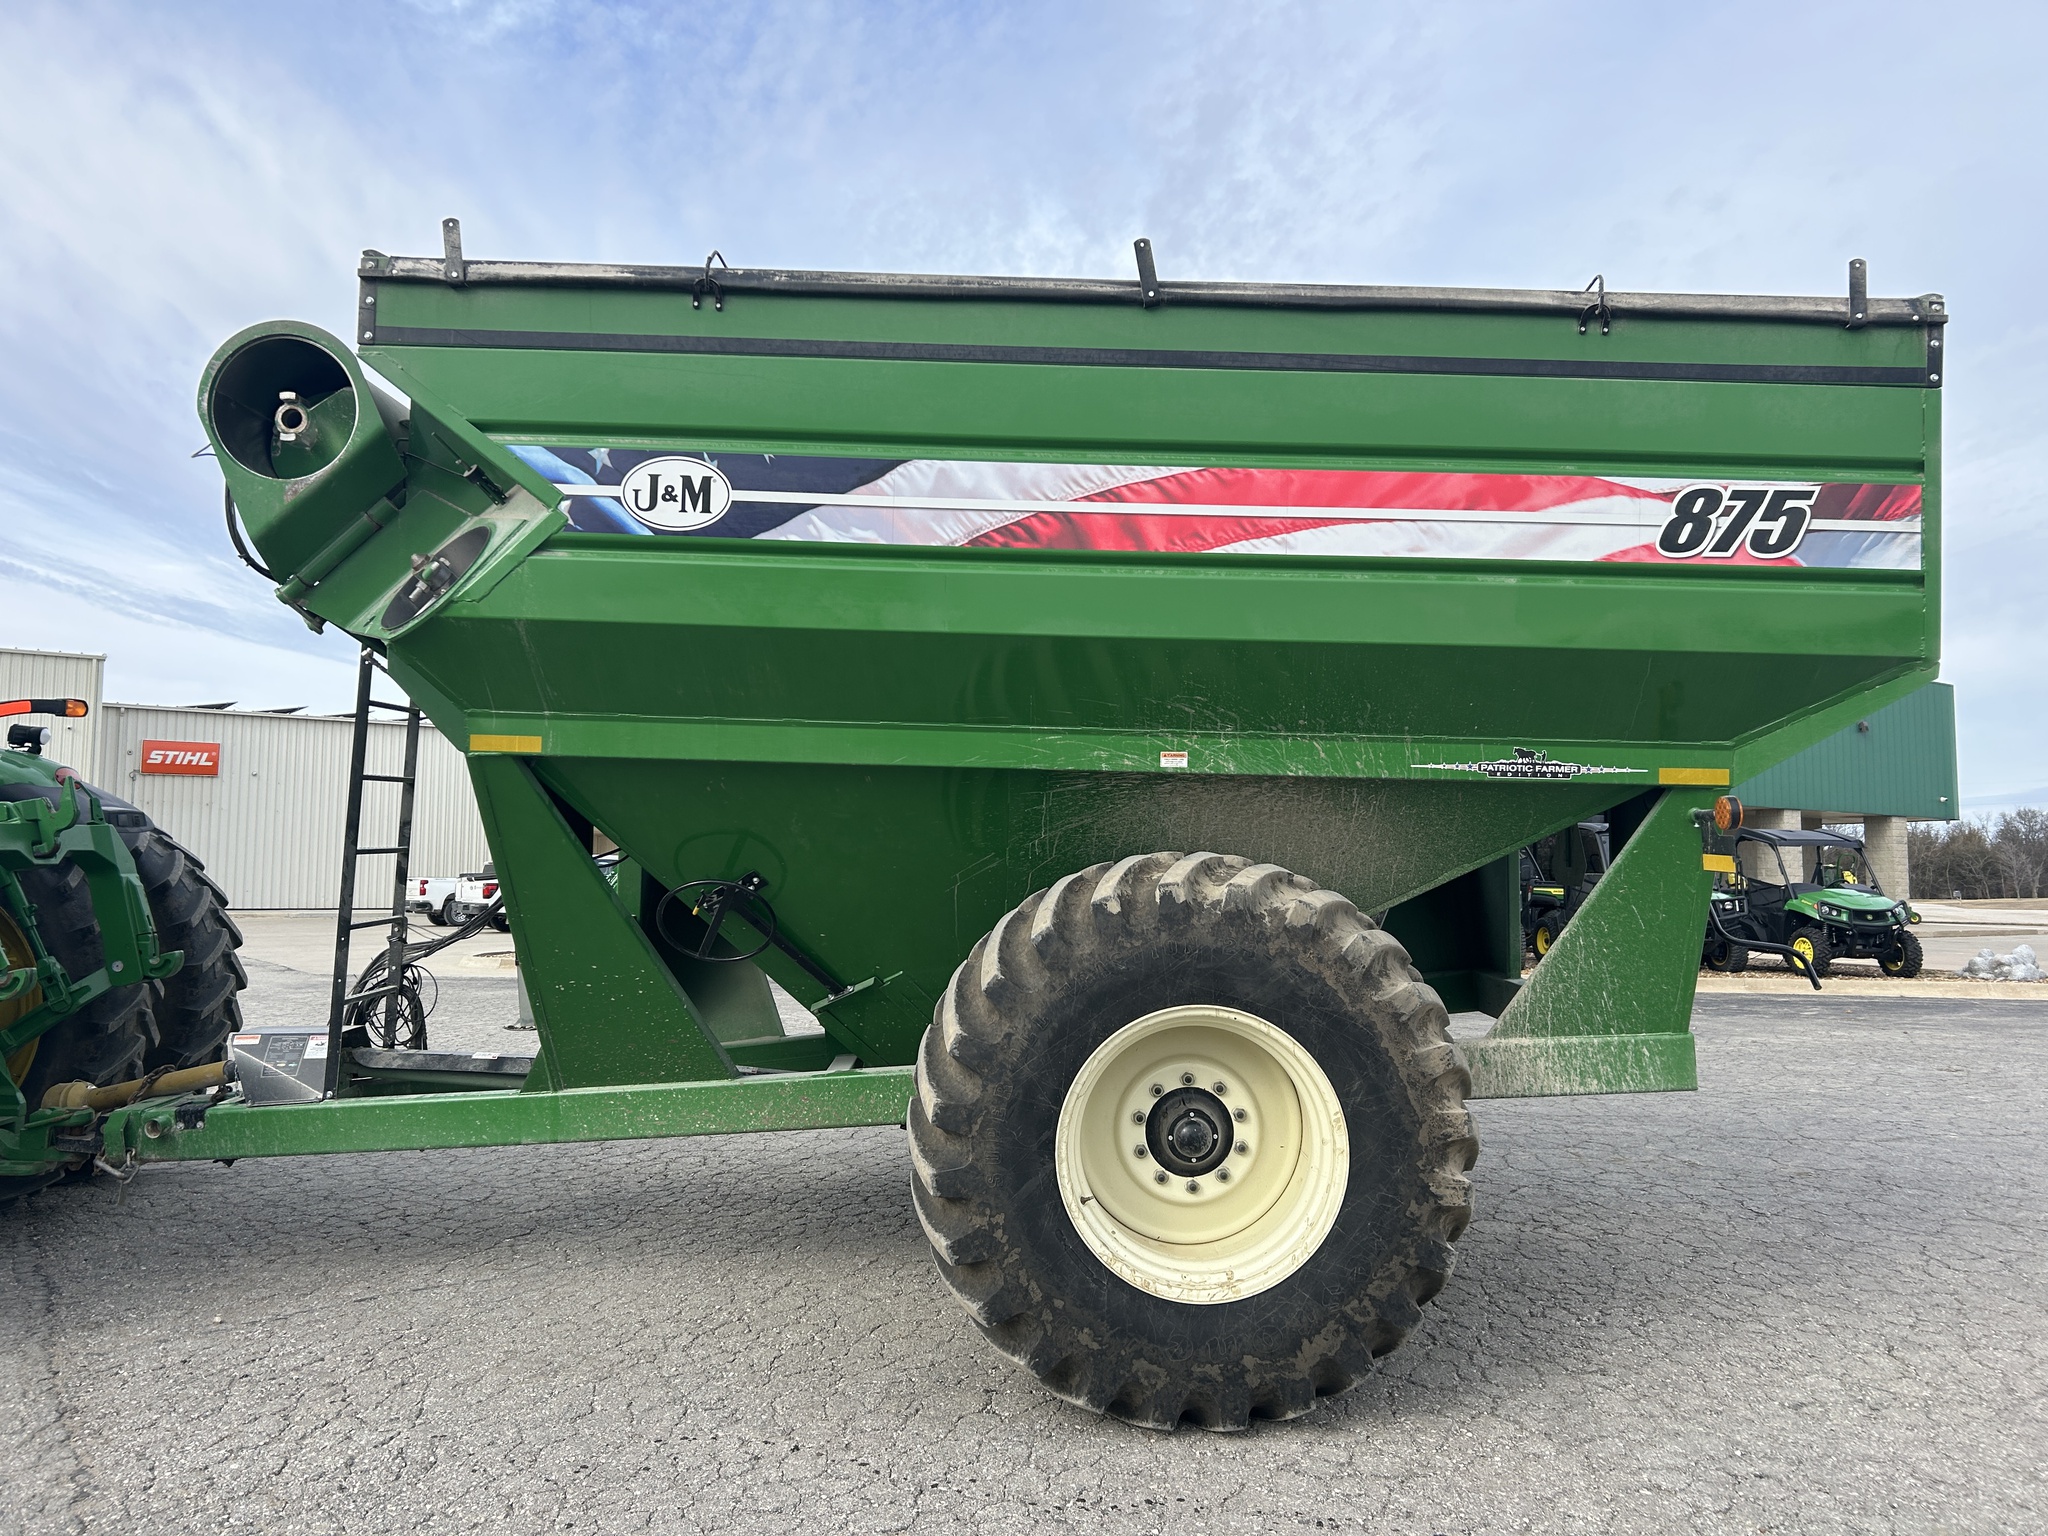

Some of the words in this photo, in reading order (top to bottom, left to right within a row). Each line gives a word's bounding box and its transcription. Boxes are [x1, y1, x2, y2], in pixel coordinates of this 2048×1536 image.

[632, 473, 713, 514] J&M
[1658, 488, 1816, 554] 875
[146, 749, 213, 766] STIHL
[1481, 764, 1533, 772] PATRIOTIC
[1535, 765, 1578, 773] FARMER
